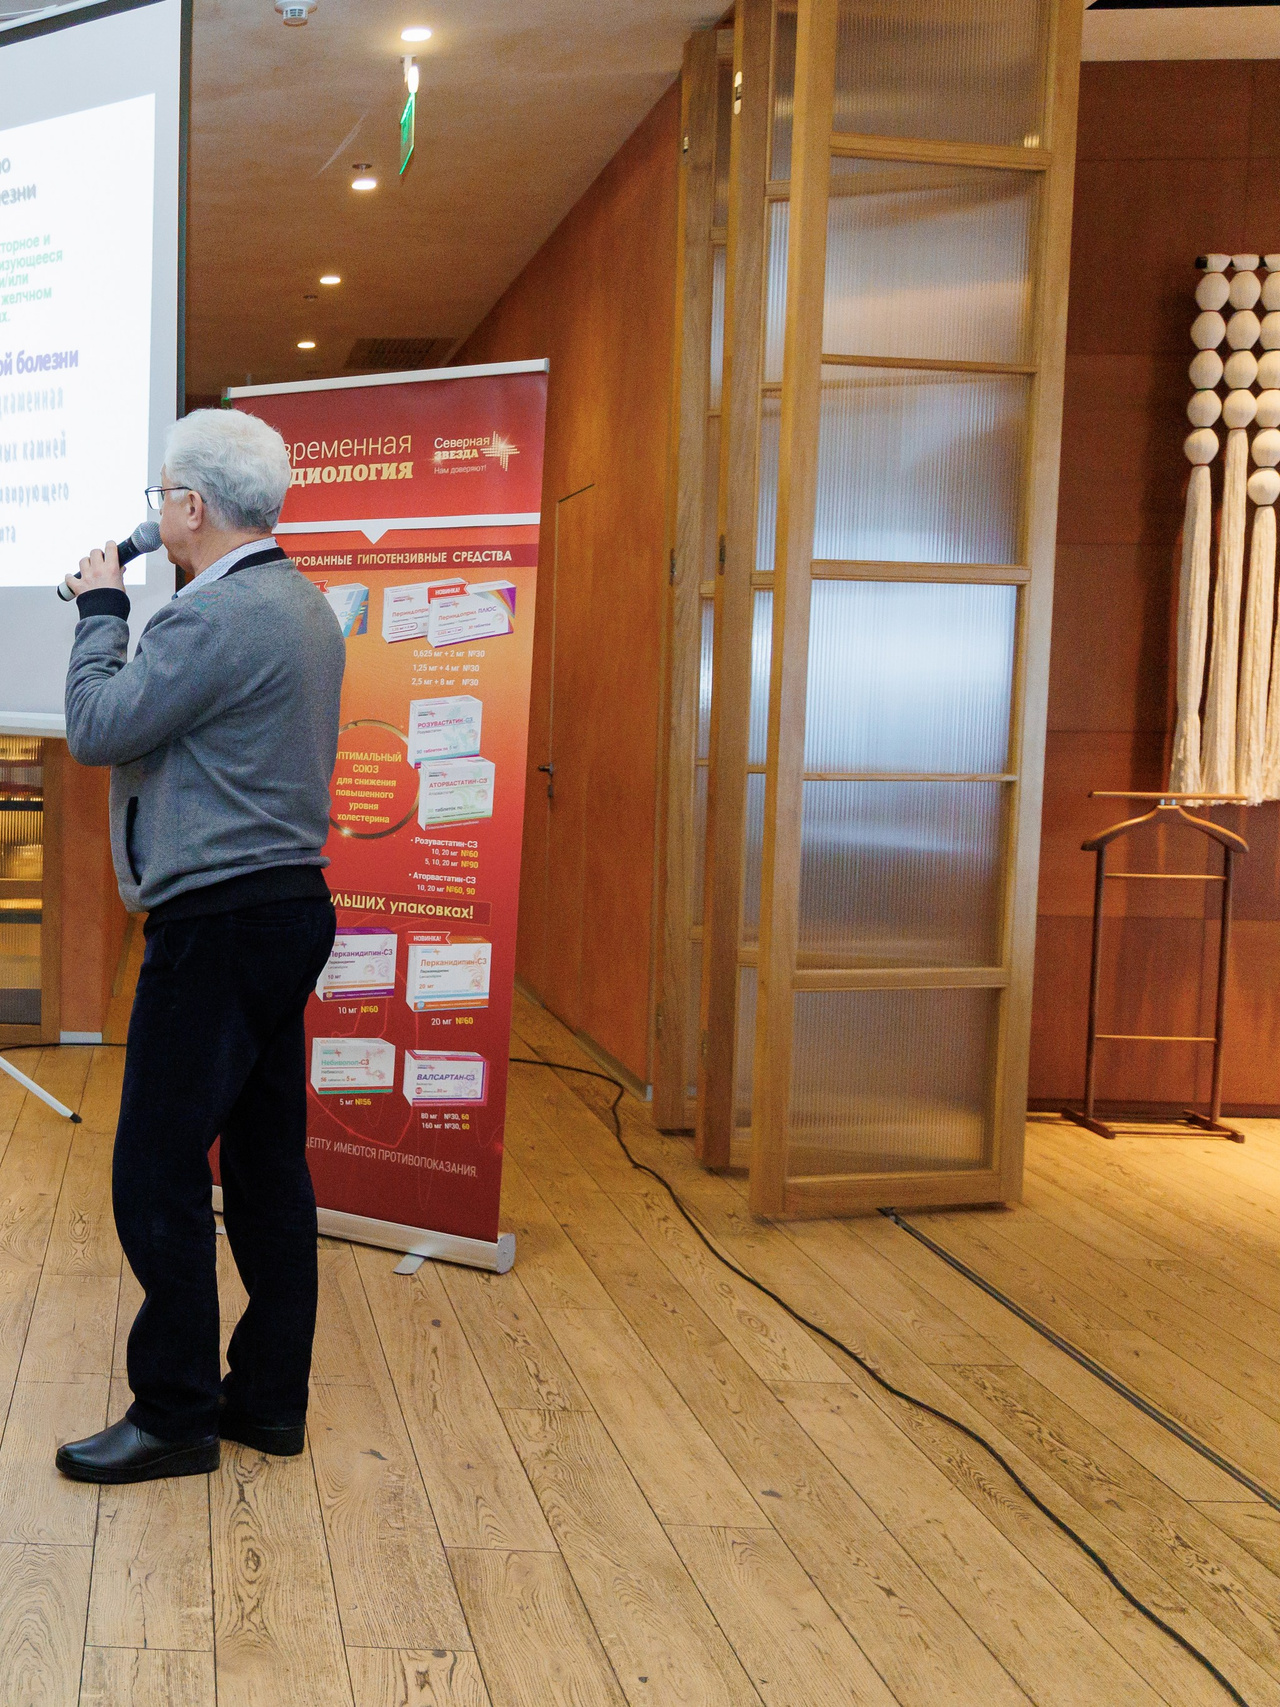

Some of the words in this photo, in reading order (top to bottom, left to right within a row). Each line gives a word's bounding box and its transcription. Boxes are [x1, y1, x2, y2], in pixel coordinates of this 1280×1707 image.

[42, 233, 51, 247] и
[1, 286, 53, 307] желчном
[16, 347, 79, 376] болезни
[23, 430, 67, 460] камней
[434, 436, 490, 450] Северная
[285, 435, 412, 467] временная
[434, 448, 479, 461] ЗВЕЗДА
[289, 461, 414, 488] диология
[434, 466, 448, 475] Нам
[450, 463, 487, 476] доверяют!
[357, 551, 447, 565] ГИПОТЕНЗИВНЫЕ
[452, 549, 512, 563] СРЕДСТВА
[413, 664, 428, 672] 1,25
[411, 678, 424, 686] 2,5
[352, 764, 379, 774] СОЮЗ
[336, 777, 353, 786] для
[354, 777, 397, 787] снижения
[335, 789, 394, 799] повышенного
[348, 802, 379, 811] уровня
[337, 813, 390, 824] холестерина
[414, 837, 478, 849] Розувастатин-СЗ
[460, 849, 478, 858] №60
[442, 859, 449, 867] 20
[450, 860, 459, 868] мг
[460, 860, 479, 868] №90
[413, 871, 476, 884] Аторвастатин-СЗ
[427, 884, 435, 892] 20
[466, 887, 475, 895] 90
[389, 899, 474, 919] упаковках!
[338, 1006, 347, 1014] 10
[360, 1005, 379, 1013] №60
[431, 1017, 441, 1026] 20
[442, 1018, 452, 1026] мг
[455, 1016, 473, 1025] №60
[339, 1098, 344, 1106] 5
[355, 1098, 372, 1106] №56
[421, 1112, 429, 1120] 80
[461, 1113, 470, 1121] 60
[334, 1141, 376, 1159] ИМЕЮТСЯ
[378, 1148, 478, 1178] ПРОТИВОПОКАЗАНИЯ.
